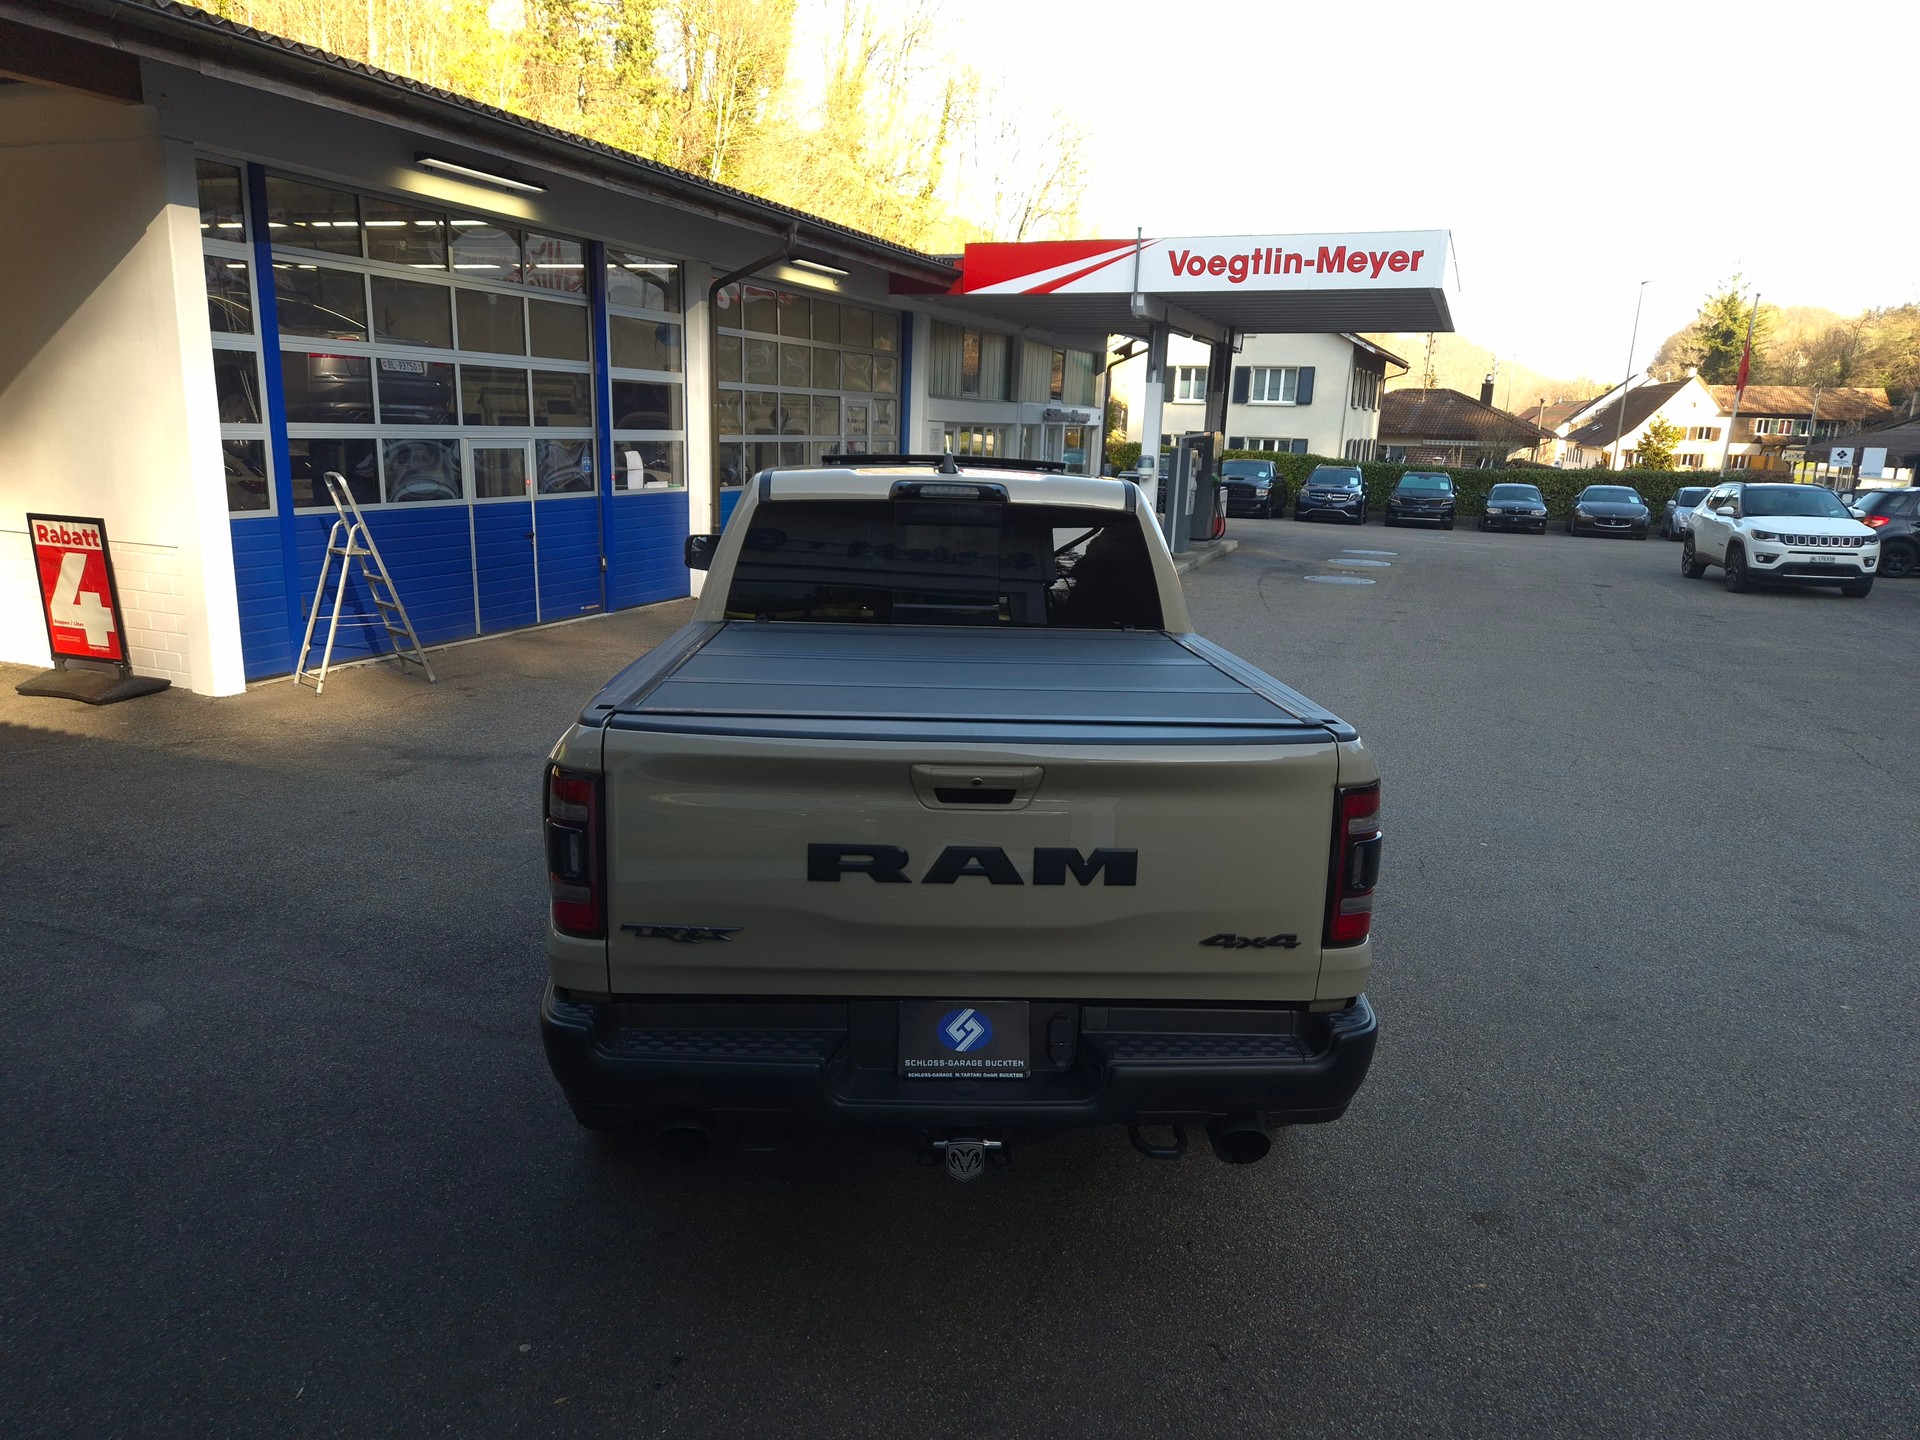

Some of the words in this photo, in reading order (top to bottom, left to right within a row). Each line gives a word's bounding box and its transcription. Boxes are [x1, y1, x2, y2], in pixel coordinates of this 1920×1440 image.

[1168, 246, 1424, 284] Voegtlin-Meyer
[36, 524, 100, 547] Rabatt
[50, 552, 115, 647] 4
[807, 843, 1139, 886] RAM
[985, 1059, 1024, 1067] BUCKTEN
